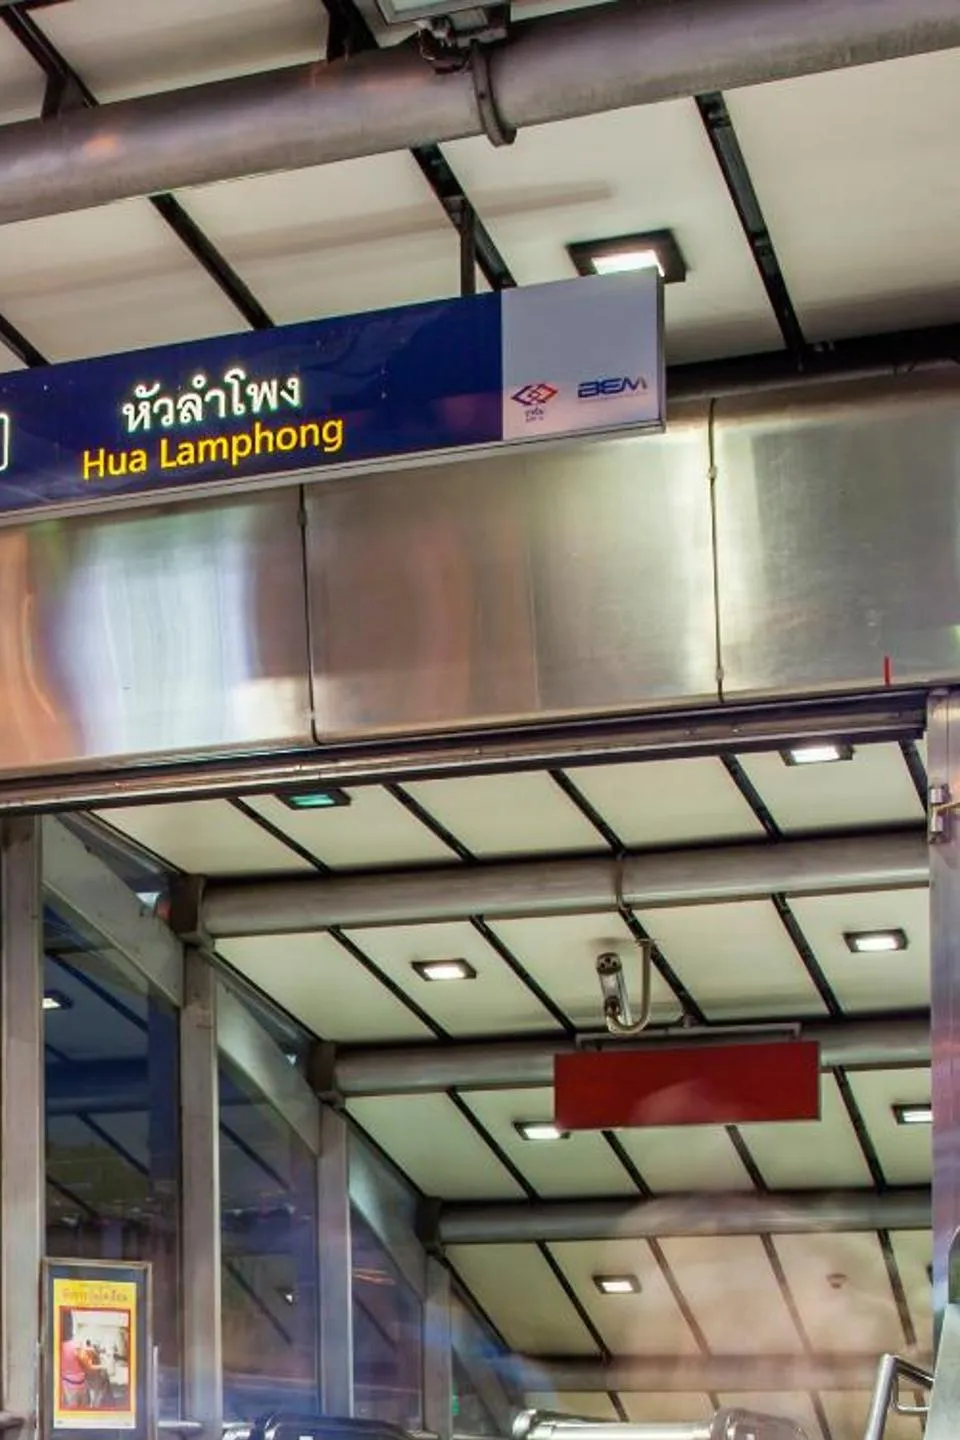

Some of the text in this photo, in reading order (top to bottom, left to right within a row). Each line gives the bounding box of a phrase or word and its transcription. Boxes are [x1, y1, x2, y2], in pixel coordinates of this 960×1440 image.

[122, 367, 301, 433] หัวลำโพง
[577, 376, 647, 398] BEM
[83, 418, 343, 480] Hua Lamphong
